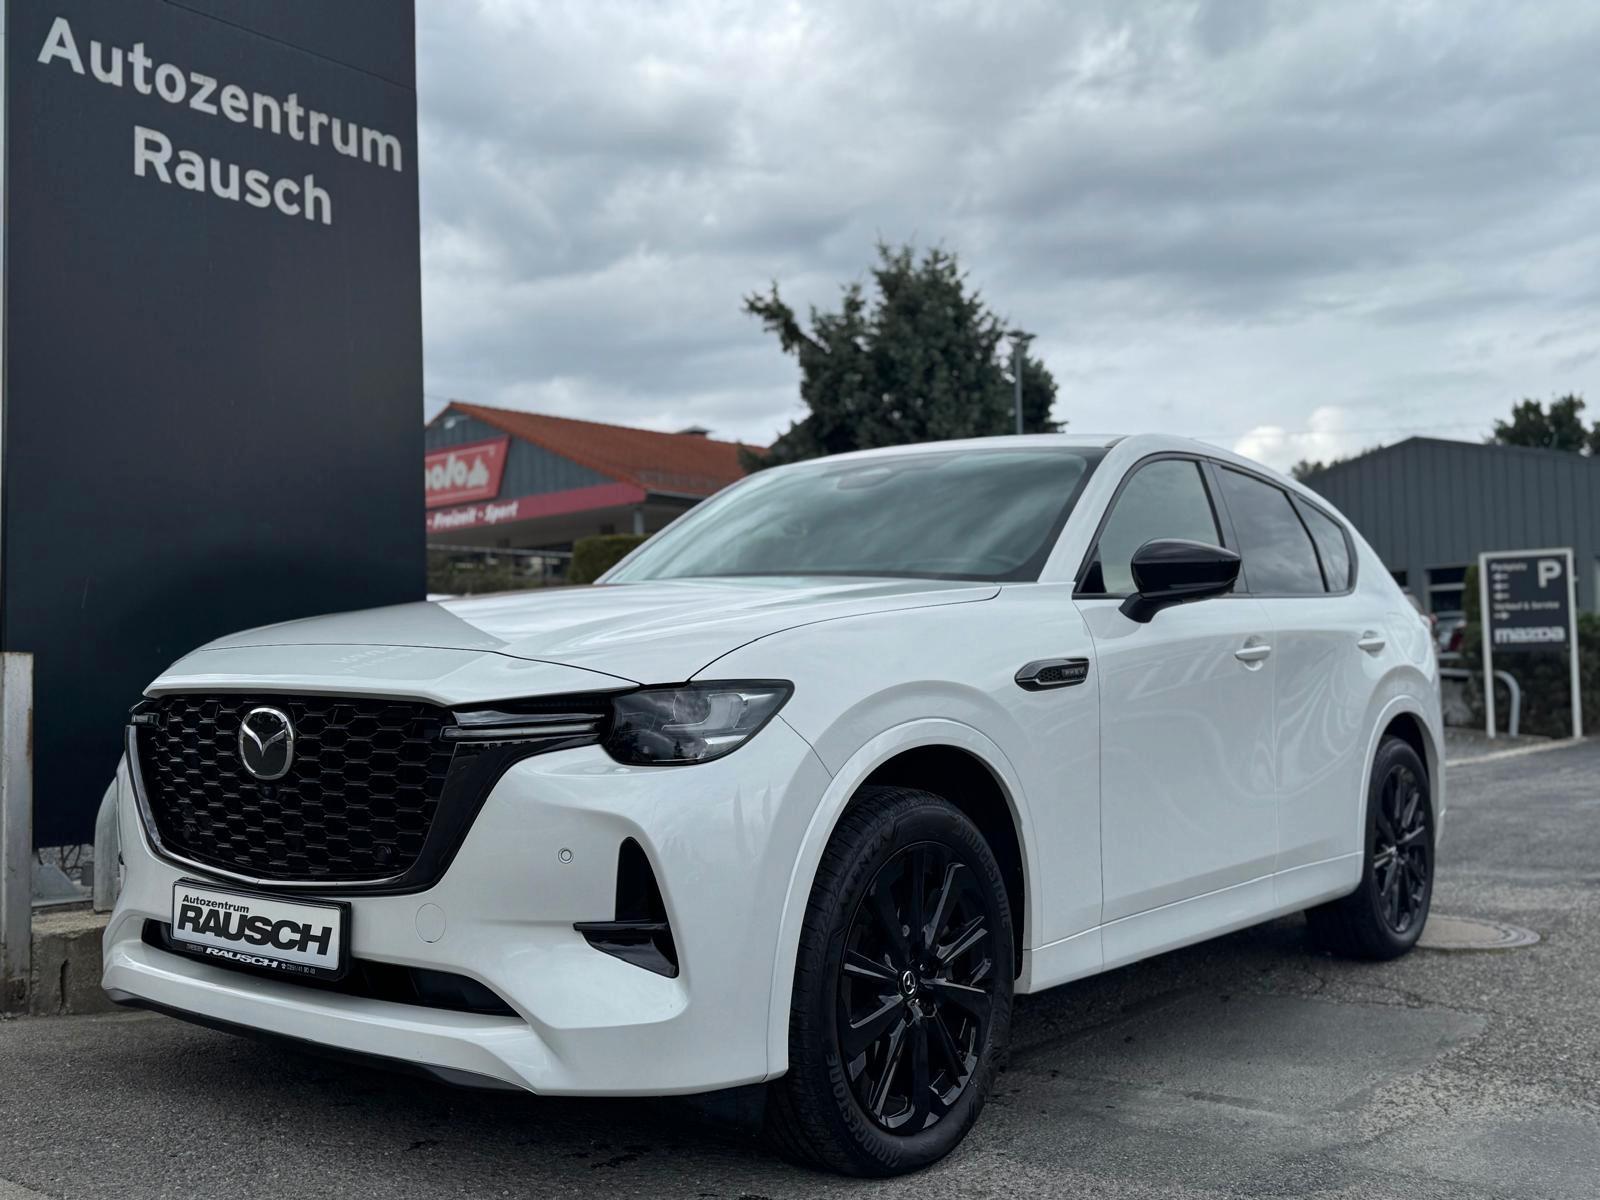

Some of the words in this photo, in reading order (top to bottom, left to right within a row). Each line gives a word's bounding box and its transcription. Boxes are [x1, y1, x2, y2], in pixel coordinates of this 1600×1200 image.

[37, 16, 402, 172] Autozentrum
[134, 125, 332, 225] Rausch
[485, 500, 519, 524] Sport
[1538, 559, 1562, 588] P
[182, 894, 250, 914] Autozentrum
[177, 903, 333, 956] RAUSCH
[206, 947, 278, 968] RAUSCH
[825, 1053, 900, 1168] BRIDGESTONE
